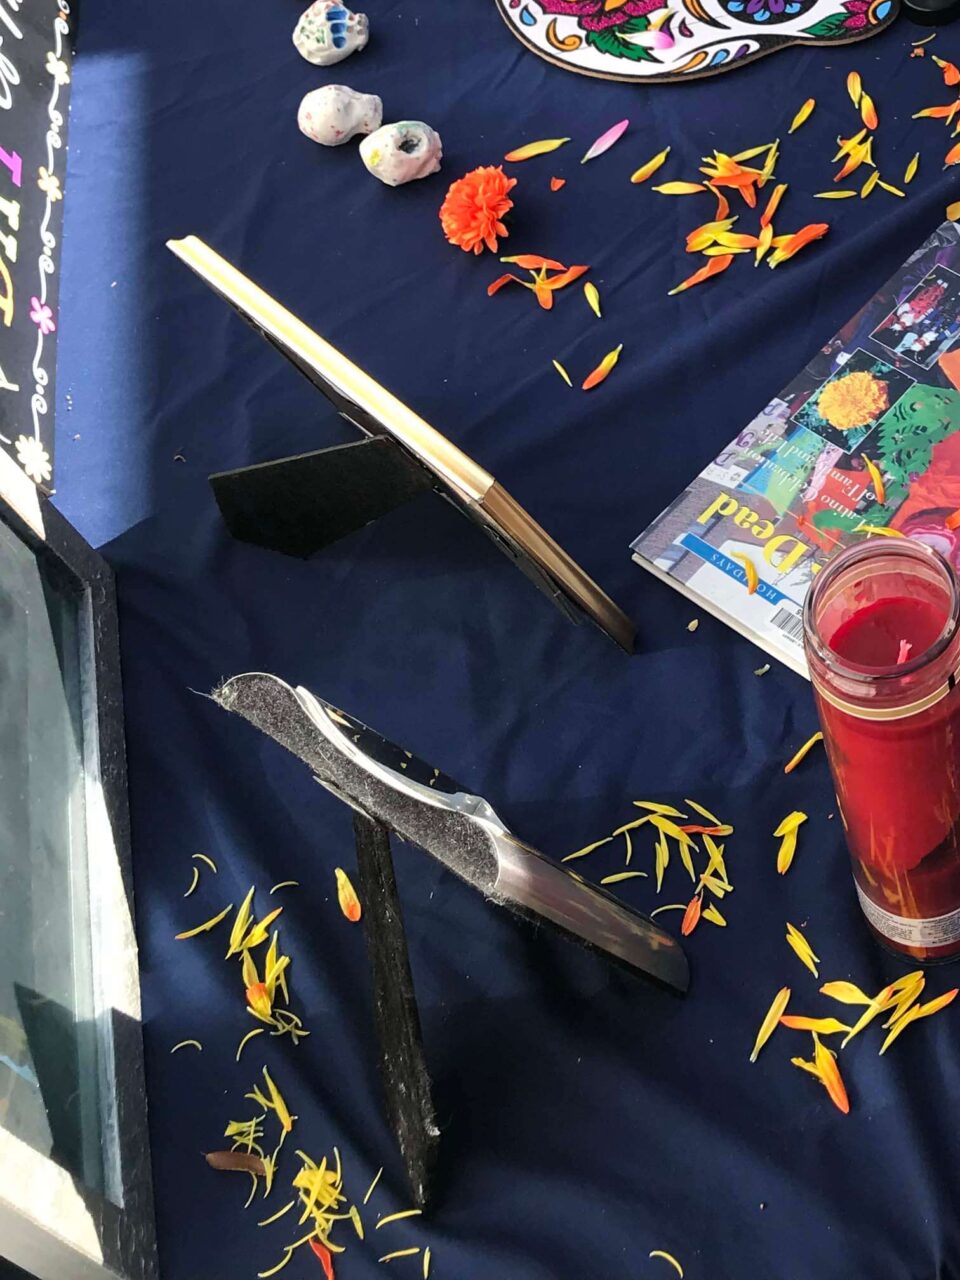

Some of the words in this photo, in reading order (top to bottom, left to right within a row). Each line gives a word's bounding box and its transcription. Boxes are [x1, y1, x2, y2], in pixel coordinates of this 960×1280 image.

[758, 429, 788, 453] Life
[789, 444, 816, 465] and
[744, 447, 819, 503] Celebration
[852, 487, 877, 502] of
[820, 493, 867, 532] Latino
[697, 492, 811, 574] Dead
[710, 553, 778, 600] HOIDAYS
